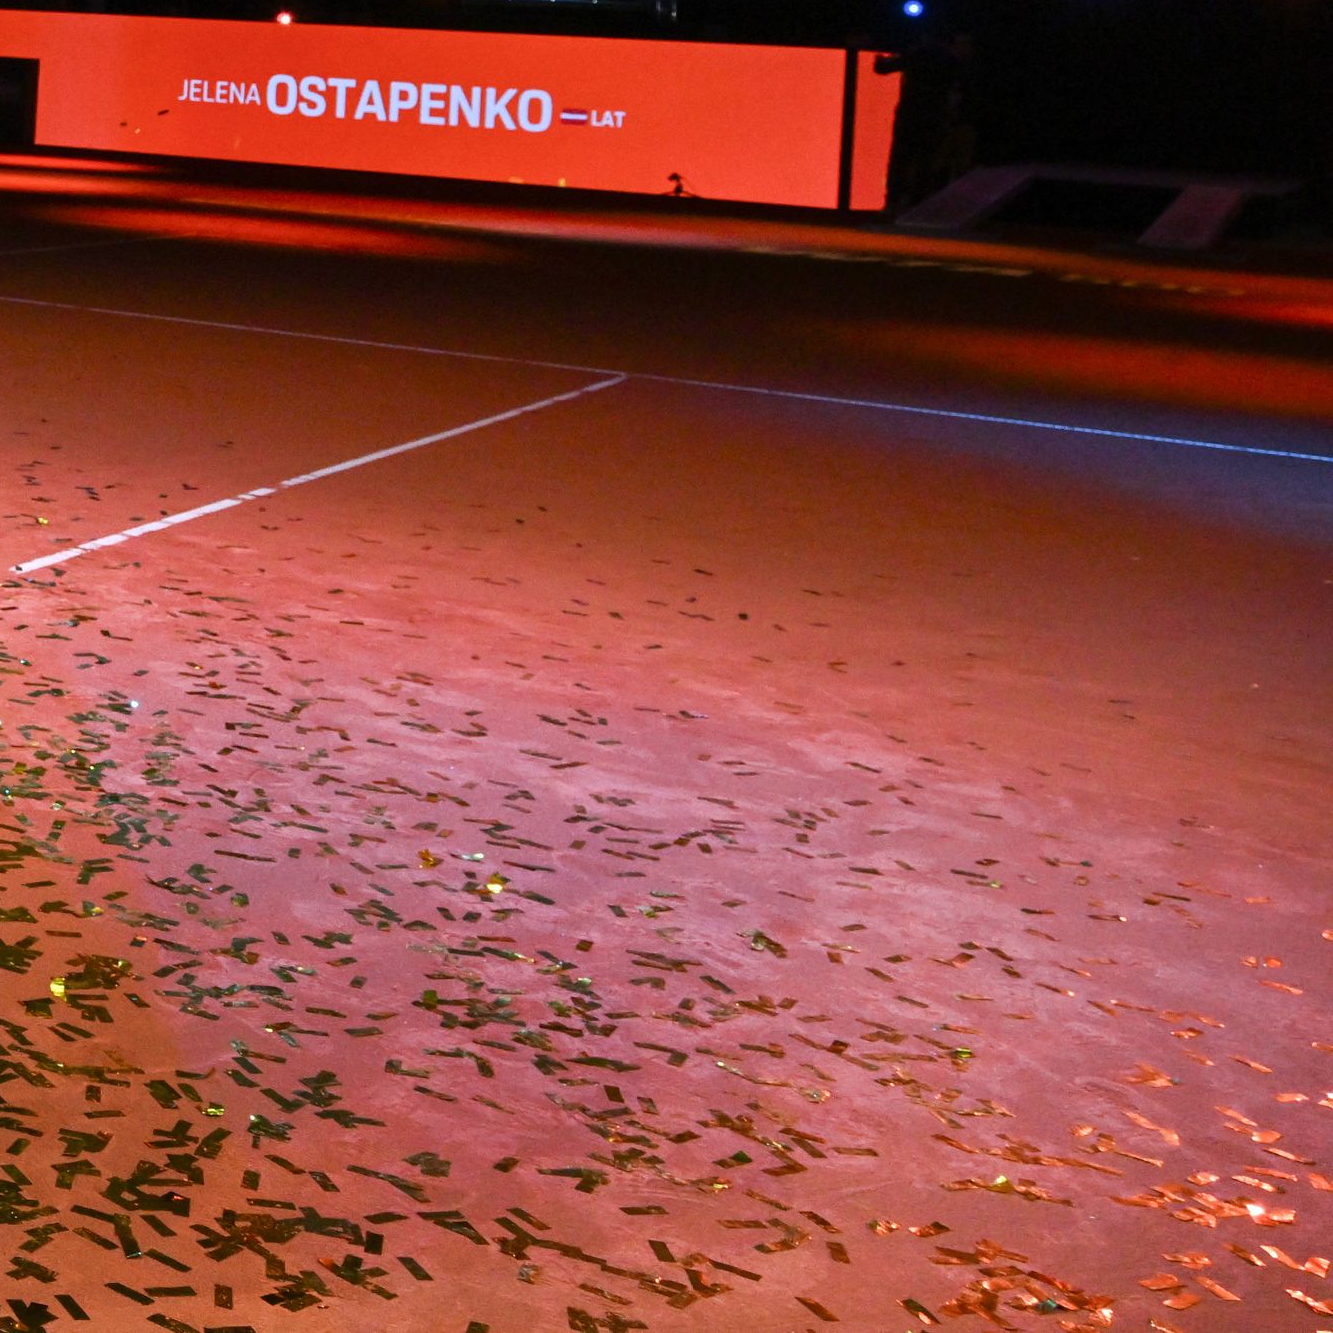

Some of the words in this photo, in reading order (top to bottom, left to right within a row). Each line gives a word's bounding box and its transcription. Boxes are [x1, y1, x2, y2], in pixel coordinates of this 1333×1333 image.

[177, 79, 262, 106] JELENA
[265, 73, 553, 133] OSTAPENKO
[590, 109, 626, 129] LAT
